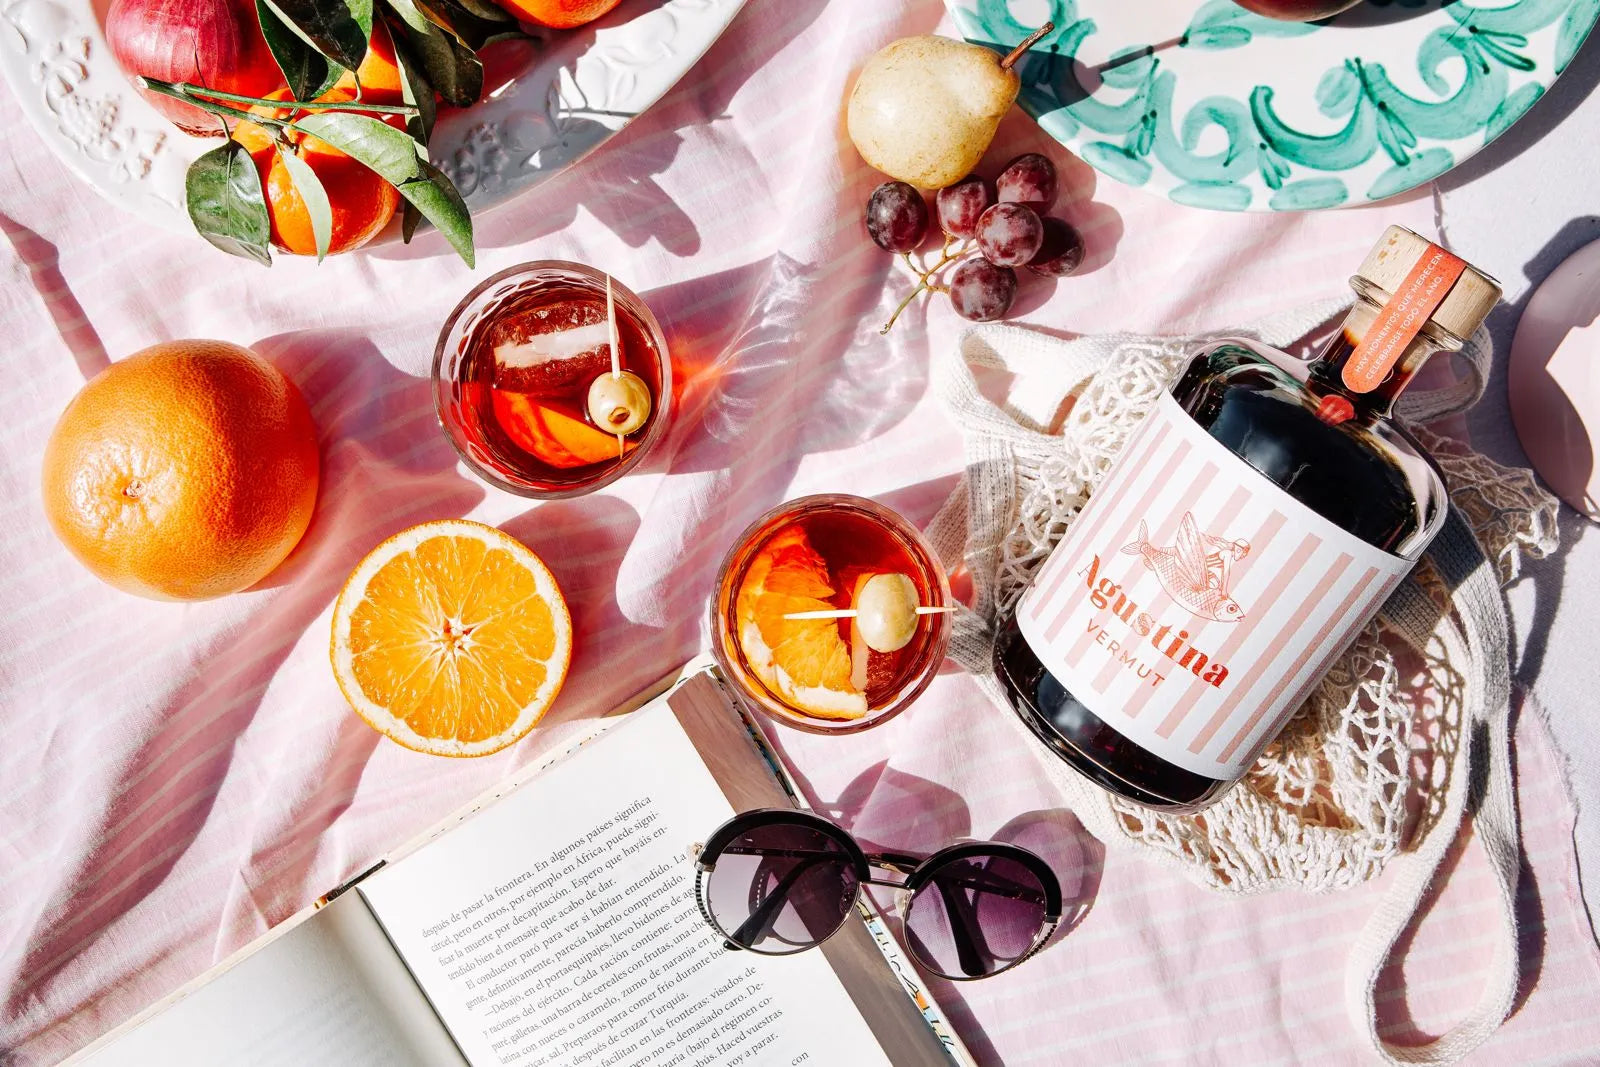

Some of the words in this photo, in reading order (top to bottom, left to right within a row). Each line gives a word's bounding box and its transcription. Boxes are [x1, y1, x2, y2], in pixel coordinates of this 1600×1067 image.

[1355, 355, 1370, 373] HAY
[1368, 312, 1400, 355] MOMENTOS
[1398, 293, 1414, 313] QUE
[1411, 252, 1443, 292] MERECEN
[1366, 331, 1403, 380] CELEBRARSE
[1401, 307, 1420, 331] TODO
[1418, 296, 1428, 308] EL
[1077, 555, 1230, 689] Agustina
[1087, 619, 1165, 687] VERMUT
[460, 898, 484, 920] pasar
[483, 893, 495, 903] la
[494, 871, 535, 897] frontera.
[533, 860, 549, 872] En
[549, 837, 586, 863] algunos
[585, 820, 614, 843] países
[613, 796, 652, 823] significa
[472, 919, 484, 930] en
[483, 906, 510, 923] otros,
[508, 894, 525, 911] por
[526, 872, 563, 898] ejemplo
[562, 864, 576, 875] en
[575, 846, 607, 868] África,
[605, 827, 634, 851] puede
[633, 810, 658, 831] signi-
[494, 922, 511, 939] por
[512, 888, 571, 926] decapitación.
[570, 866, 604, 889] Espero
[604, 854, 622, 869] que
[621, 835, 652, 857] hayáis
[652, 827, 667, 838] en-
[494, 944, 504, 956] el
[503, 925, 539, 951] mensaje
[540, 914, 558, 930] que
[557, 898, 585, 918] acabo
[585, 889, 598, 901] de
[597, 878, 617, 893] dar.
[519, 942, 541, 964] paró
[541, 931, 563, 950] para
[563, 920, 579, 933] ver
[581, 911, 591, 923] si
[589, 893, 624, 917] habían
[624, 864, 673, 896] entendido.
[672, 853, 687, 864] La
[523, 987, 536, 997] en
[535, 978, 545, 990] el
[543, 942, 613, 988] portaequipajes,
[609, 926, 634, 944] llevo
[632, 903, 670, 930] bidones
[670, 895, 682, 907] de
[554, 936, 588, 962] parecía
[585, 914, 622, 939] haberlo
[622, 875, 686, 917] comprendido.
[521, 1003, 536, 1017] del
[537, 986, 573, 1009] ejército.
[573, 969, 598, 987] Cada
[599, 949, 629, 972] ración
[630, 921, 673, 952] contiene:
[537, 1026, 567, 1047] nueces
[568, 1022, 575, 1030] o
[576, 996, 621, 1025] caramelo,
[620, 977, 648, 998] zumo
[649, 968, 662, 980] de
[661, 946, 697, 972] naranja
[697, 937, 710, 949] en
[540, 1012, 559, 1026] una
[555, 999, 582, 1017] barra
[581, 991, 593, 1002] de
[592, 970, 628, 995] cereales
[627, 959, 645, 974] con
[643, 942, 674, 963] frutas,
[672, 929, 691, 944] una
[548, 1046, 563, 1059] sal.
[561, 1022, 607, 1052] Preparaos
[606, 1010, 628, 1029] para
[628, 990, 657, 1013] comer
[656, 980, 675, 994] frío
[675, 956, 711, 983] durante
[600, 1043, 638, 1066] facilitan
[639, 1035, 652, 1046] en
[650, 1025, 666, 1038] las
[709, 975, 744, 999] visados
[744, 966, 756, 978] de
[572, 1042, 607, 1065] después
[607, 1034, 620, 1046] de
[619, 1016, 648, 1038] cruzar
[647, 992, 689, 1019] Turquía.
[651, 1046, 665, 1058] no
[665, 1039, 676, 1049] es
[675, 1008, 724, 1042] demasiado
[724, 994, 747, 1011] caro.
[745, 983, 764, 996] De-
[685, 1037, 710, 1056] (bajo
[710, 1027, 720, 1039] el
[720, 1005, 758, 1033] régimen
[758, 997, 773, 1008] co-
[715, 1030, 747, 1055] Haced
[745, 1009, 783, 1035] vuestras
[726, 1053, 743, 1067] voy
[744, 1050, 751, 1058] a
[750, 1032, 779, 1055] parar.
[791, 1052, 809, 1066] con
